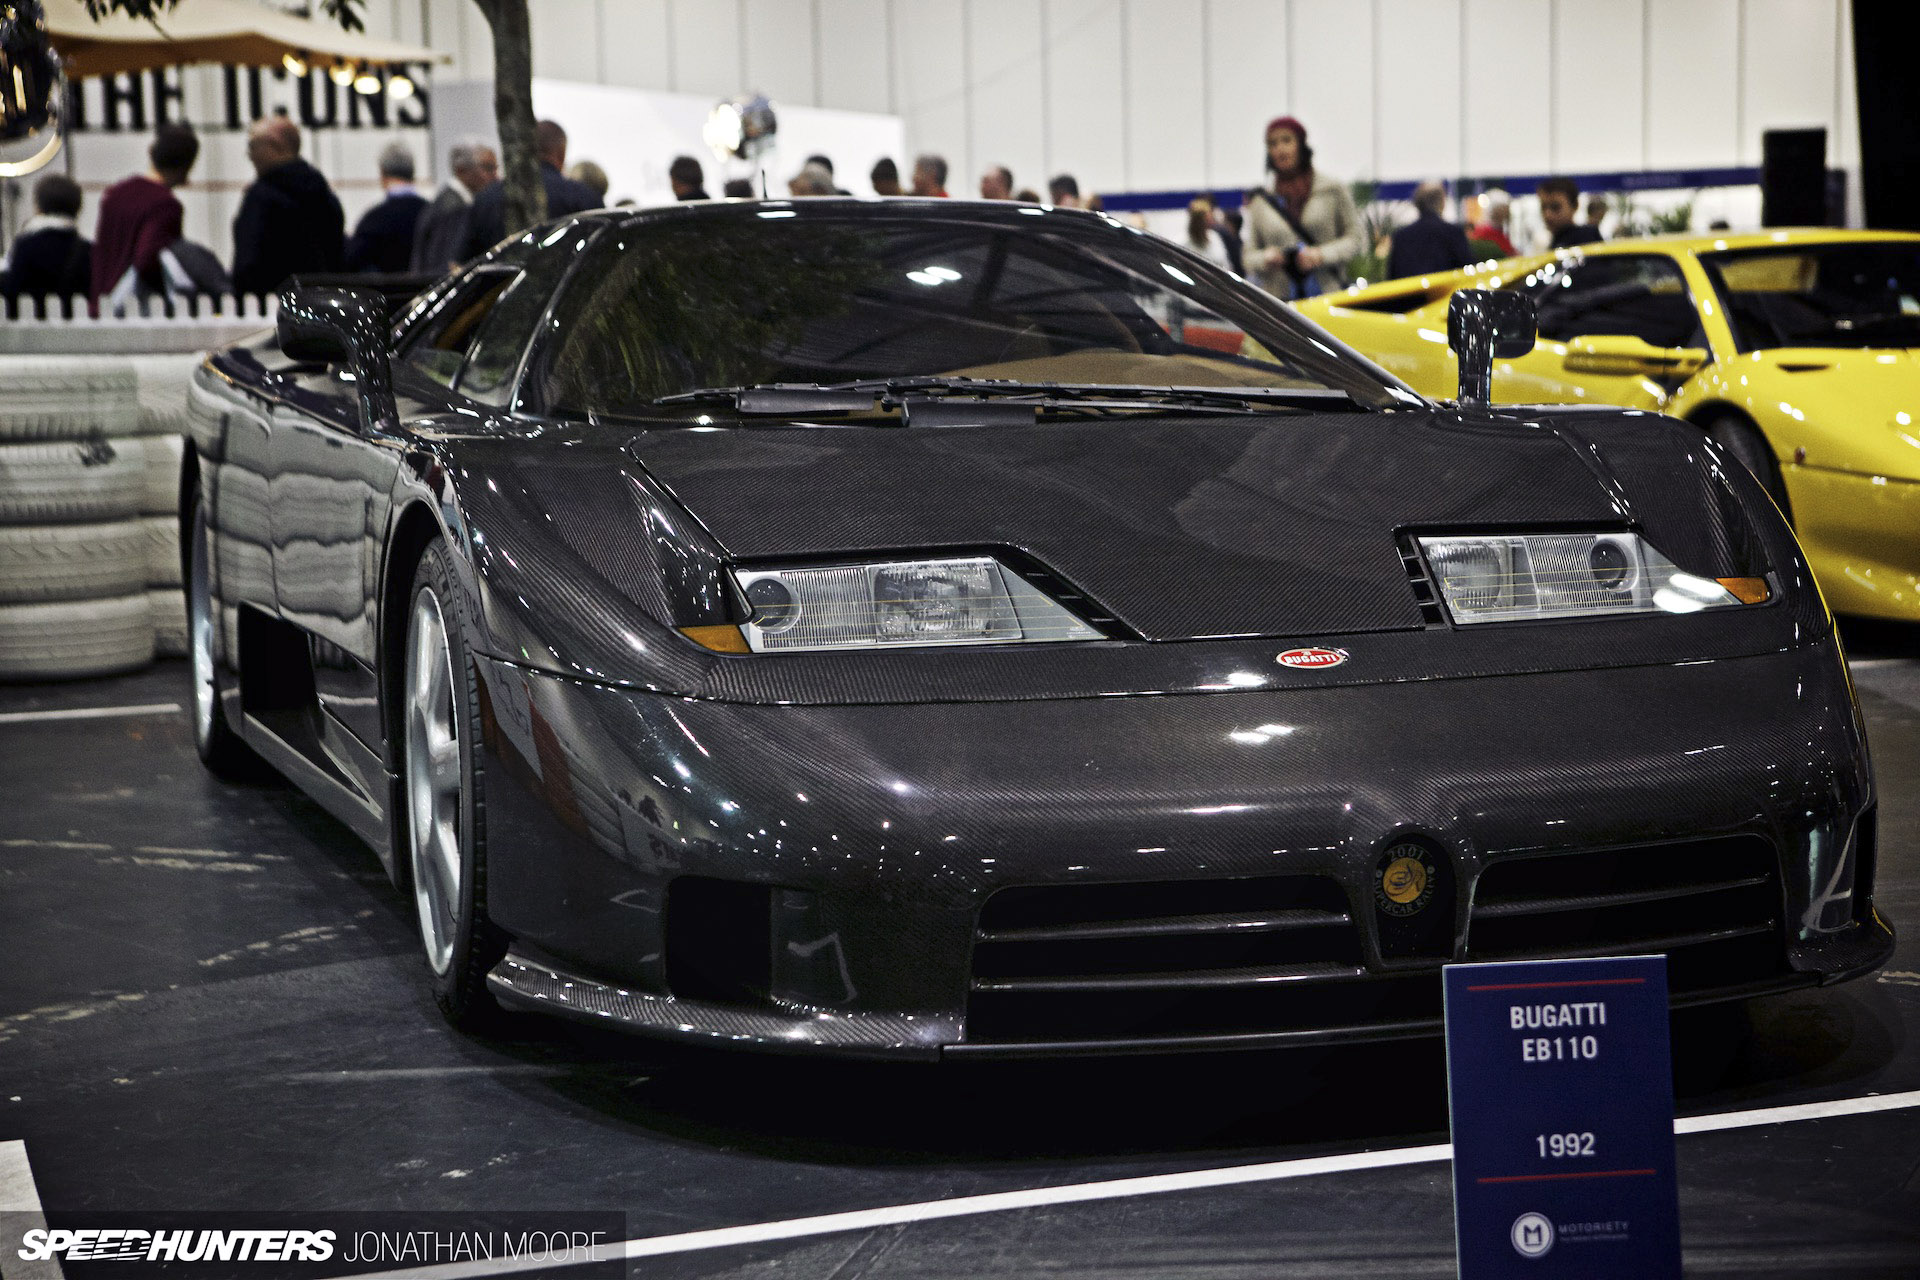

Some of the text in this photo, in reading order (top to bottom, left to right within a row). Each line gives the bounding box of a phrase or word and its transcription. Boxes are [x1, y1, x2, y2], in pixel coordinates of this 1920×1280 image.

[1284, 654, 1338, 664] BUGATTI
[1510, 1002, 1606, 1029] BUGATTI
[1522, 1035, 1598, 1062] EB110
[1536, 1132, 1596, 1158] 1992
[1558, 1220, 1630, 1234] MOTORIETY
